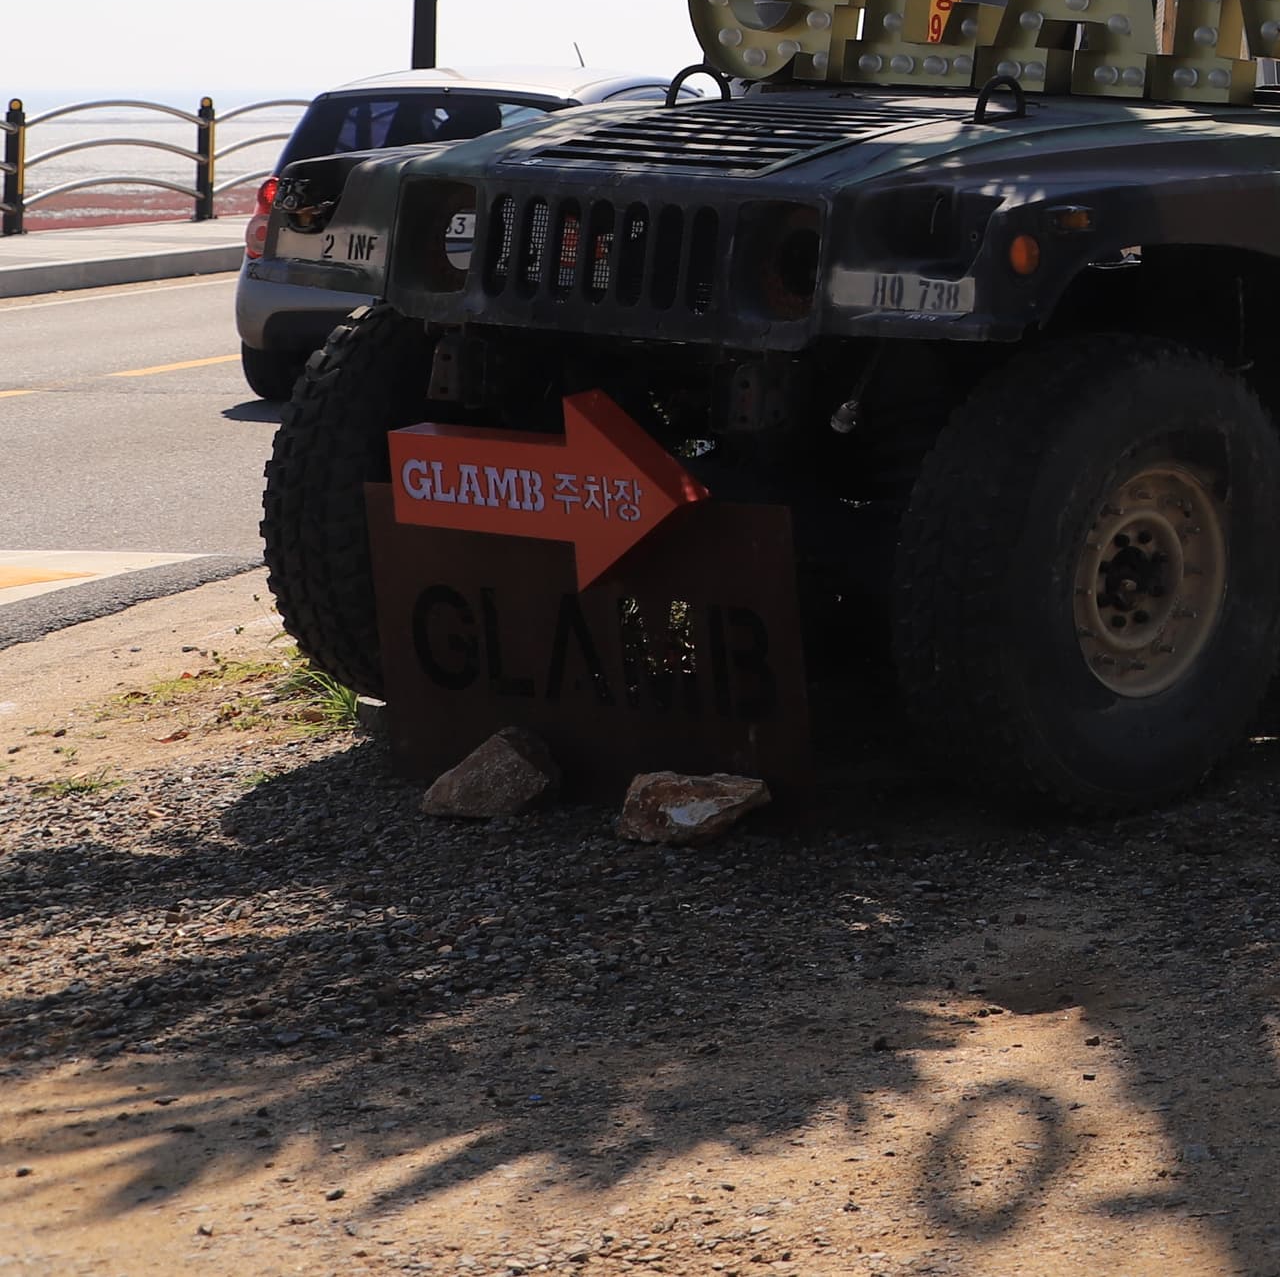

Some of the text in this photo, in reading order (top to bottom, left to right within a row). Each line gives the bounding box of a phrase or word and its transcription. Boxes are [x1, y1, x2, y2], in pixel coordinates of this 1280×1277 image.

[322, 233, 378, 261] 2 INF
[919, 280, 960, 310] 738
[401, 457, 643, 521] GLAMB 주차장
